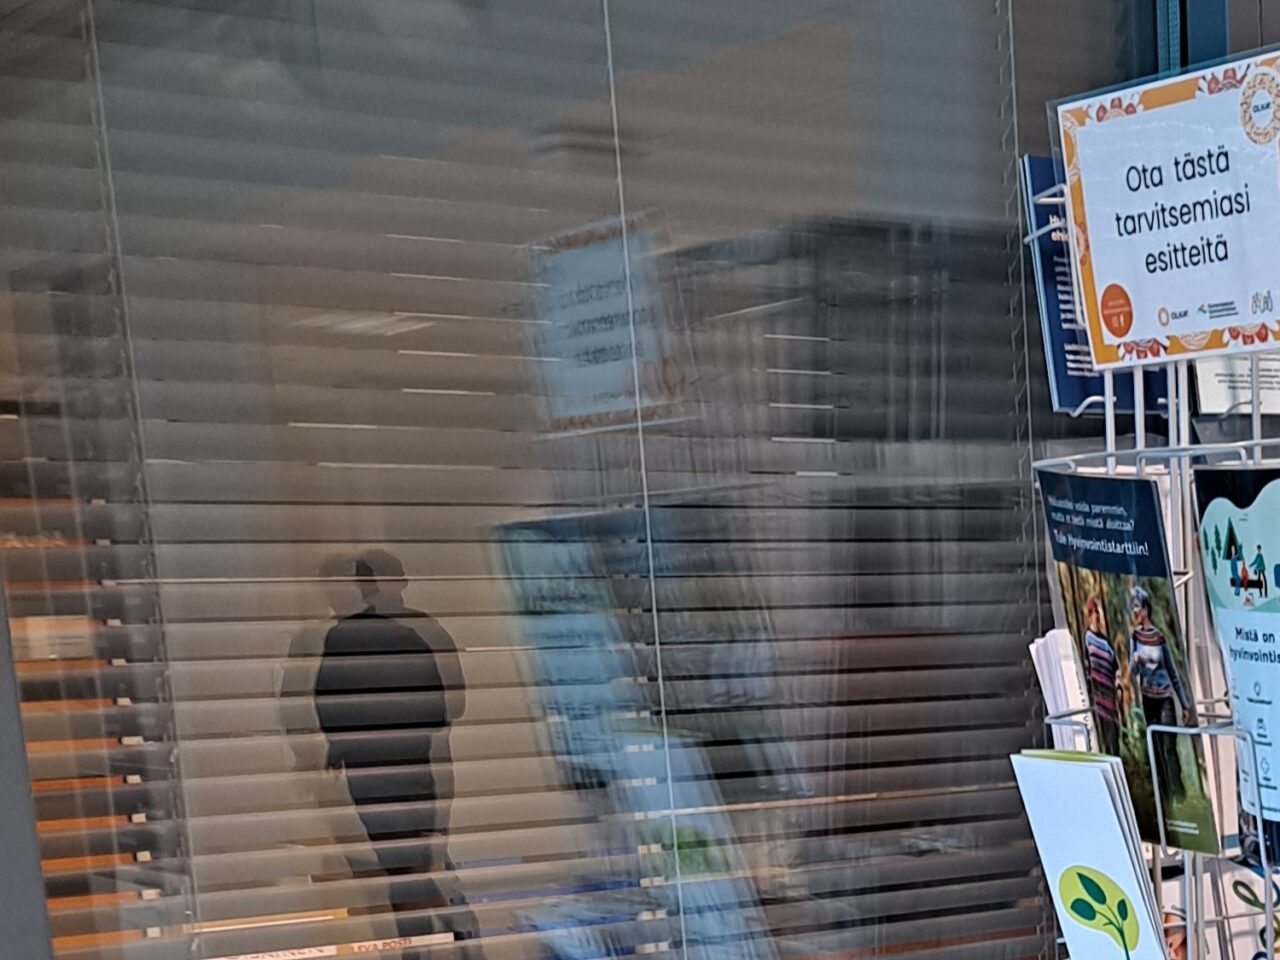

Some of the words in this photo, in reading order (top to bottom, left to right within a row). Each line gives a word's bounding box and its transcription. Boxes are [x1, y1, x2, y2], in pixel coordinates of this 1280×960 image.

[1126, 164, 1163, 192] Ota
[1174, 145, 1230, 179] tästä
[1116, 185, 1250, 237] tarvitsemiasi
[1145, 234, 1228, 274] esitteitä
[1235, 626, 1259, 642] Mistä
[1262, 633, 1275, 643] on
